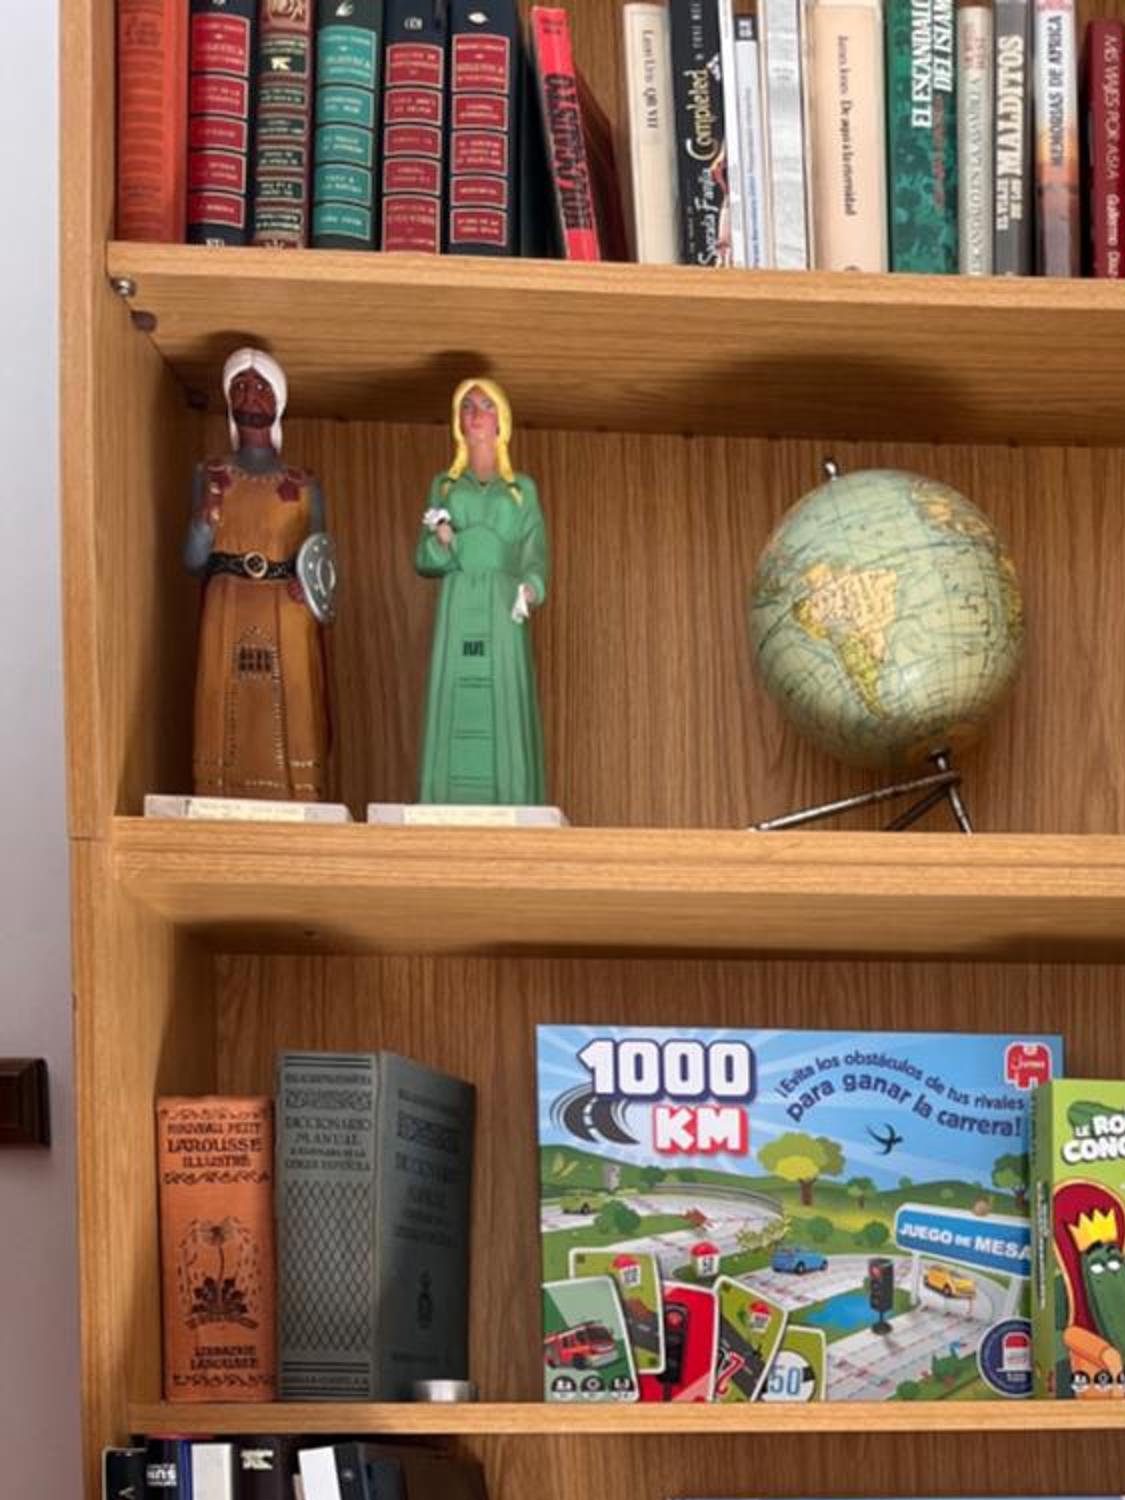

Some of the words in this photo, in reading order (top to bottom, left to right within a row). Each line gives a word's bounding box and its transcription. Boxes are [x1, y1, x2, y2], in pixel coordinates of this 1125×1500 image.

[933, 57, 954, 93] DEL
[1049, 68, 1062, 87] DE
[647, 109, 658, 129] VII
[682, 67, 719, 161] Completed
[841, 99, 853, 116] De
[911, 105, 933, 129] EL
[996, 34, 1024, 177] MALDITOS
[1049, 92, 1064, 168] MEMORIAS
[1106, 144, 1121, 180] ASIA
[843, 162, 857, 216] eternidad
[996, 216, 1009, 231] EL
[579, 1038, 757, 1099] 1000
[815, 1052, 841, 1073] los
[843, 1050, 925, 1081] obstáculos
[925, 1070, 946, 1095] de
[946, 1087, 971, 1107] tus
[974, 1092, 1026, 1112] rivales
[786, 1078, 836, 1122] para
[841, 1072, 912, 1106] ganar
[911, 1092, 934, 1120] la
[936, 1107, 1023, 1138] carrera!
[167, 1138, 263, 1153] LAROUSSE
[652, 1104, 750, 1154] KM
[1075, 1124, 1090, 1138] LE
[899, 1221, 953, 1246] JUEGO
[769, 1366, 801, 1397] 50
